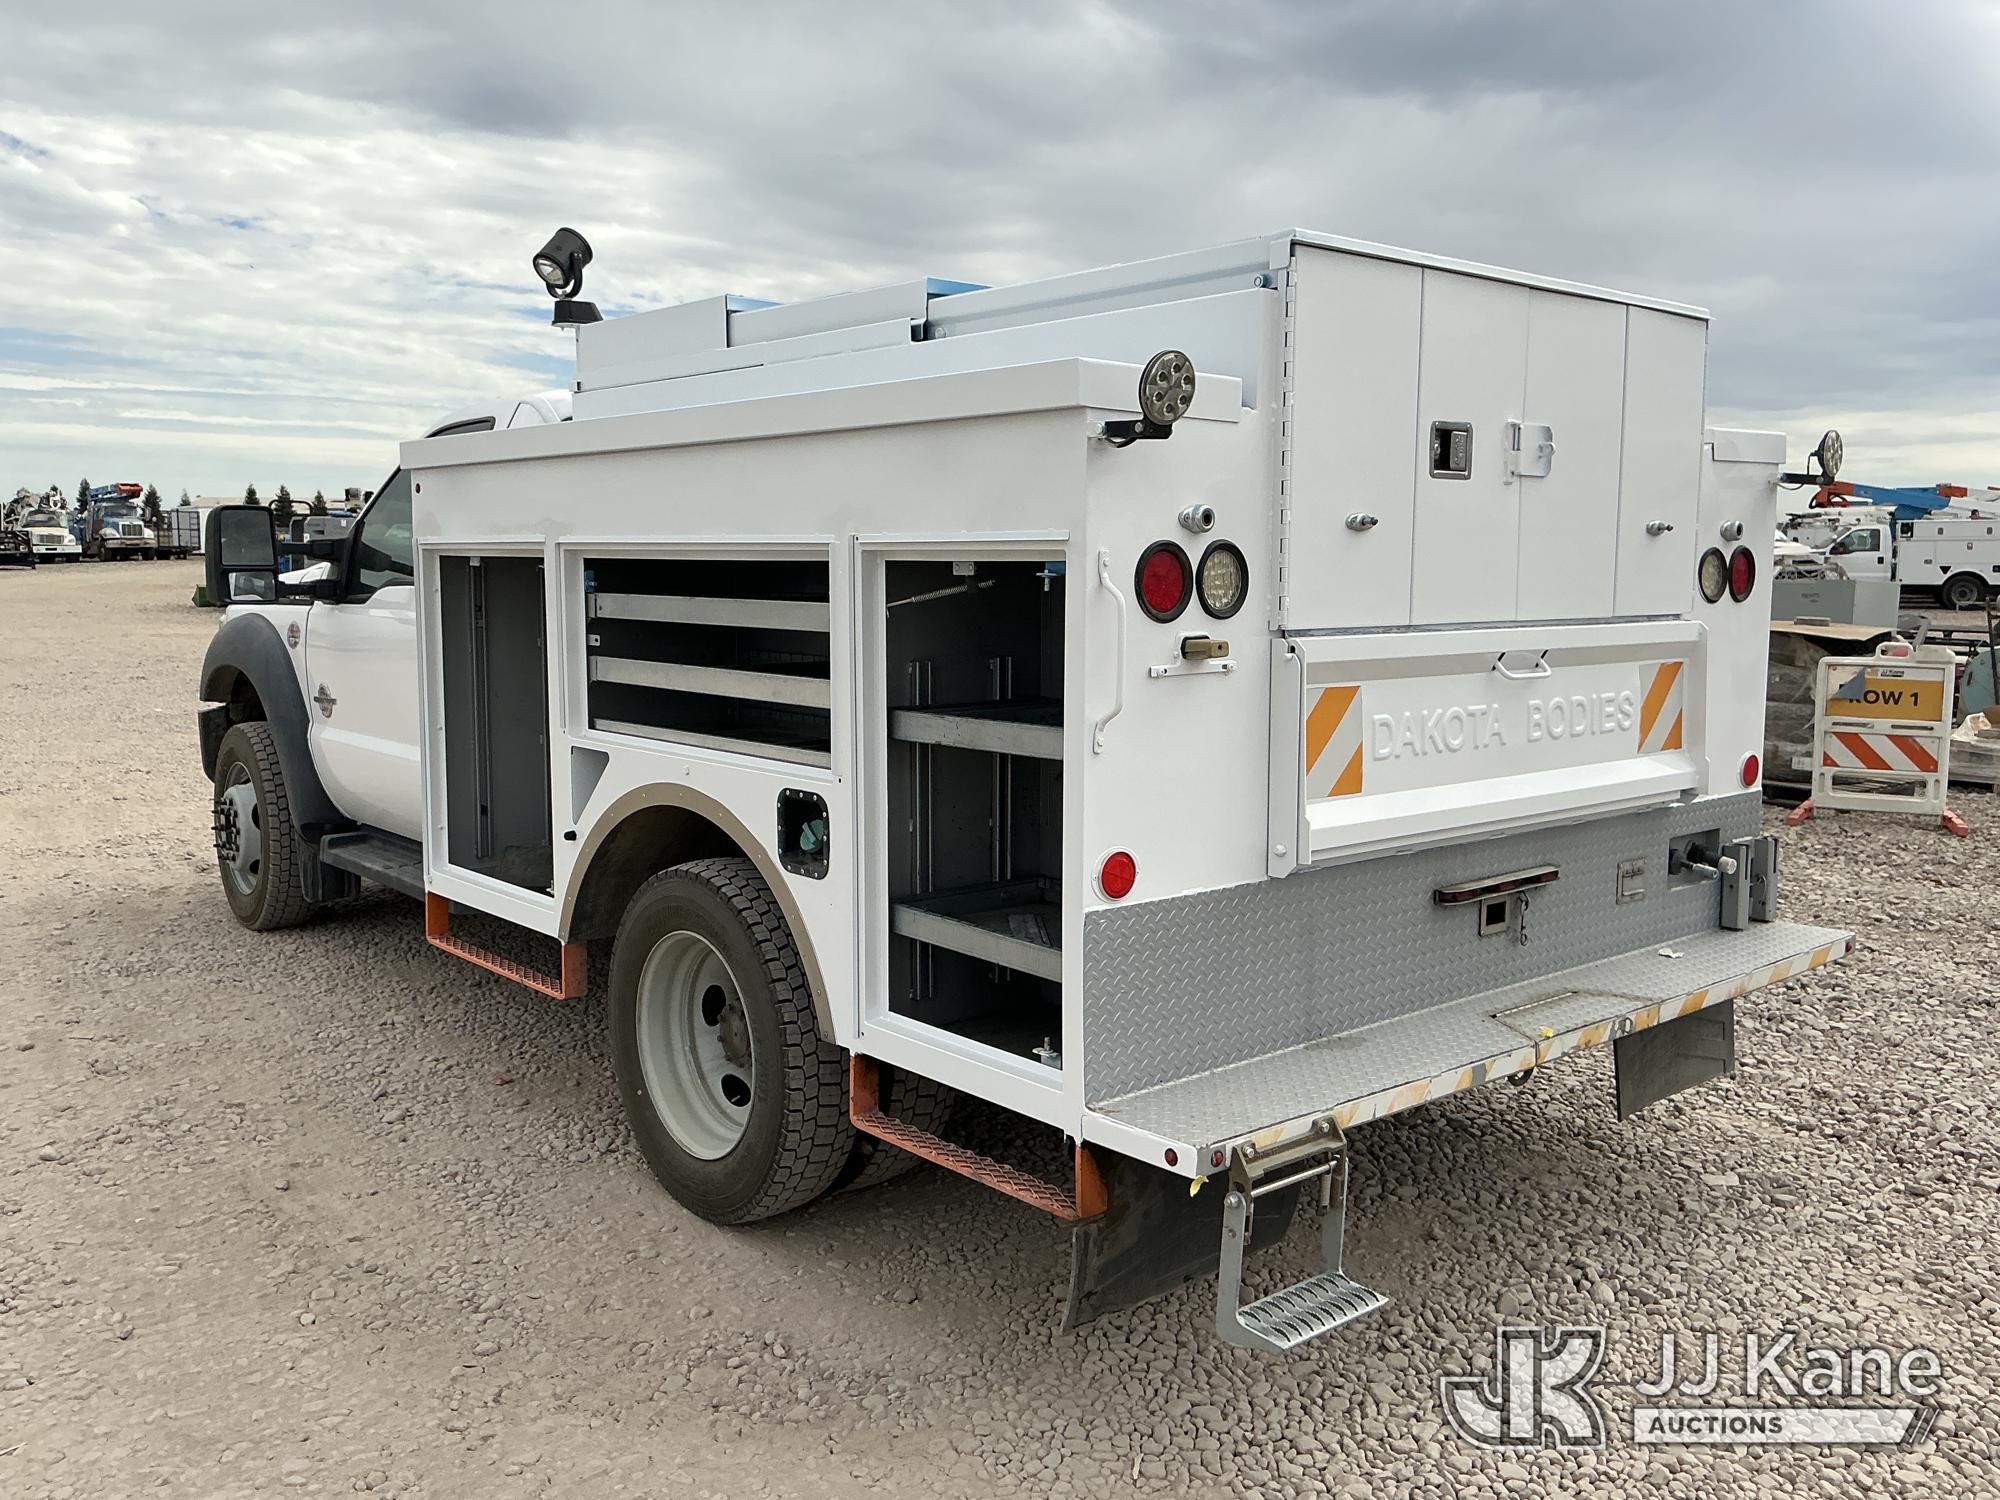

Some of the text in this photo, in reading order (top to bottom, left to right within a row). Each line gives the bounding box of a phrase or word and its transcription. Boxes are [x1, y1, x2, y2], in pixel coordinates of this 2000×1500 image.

[1848, 690, 1919, 706] OW 1
[1372, 690, 1636, 760] DAKOTA BODIES
